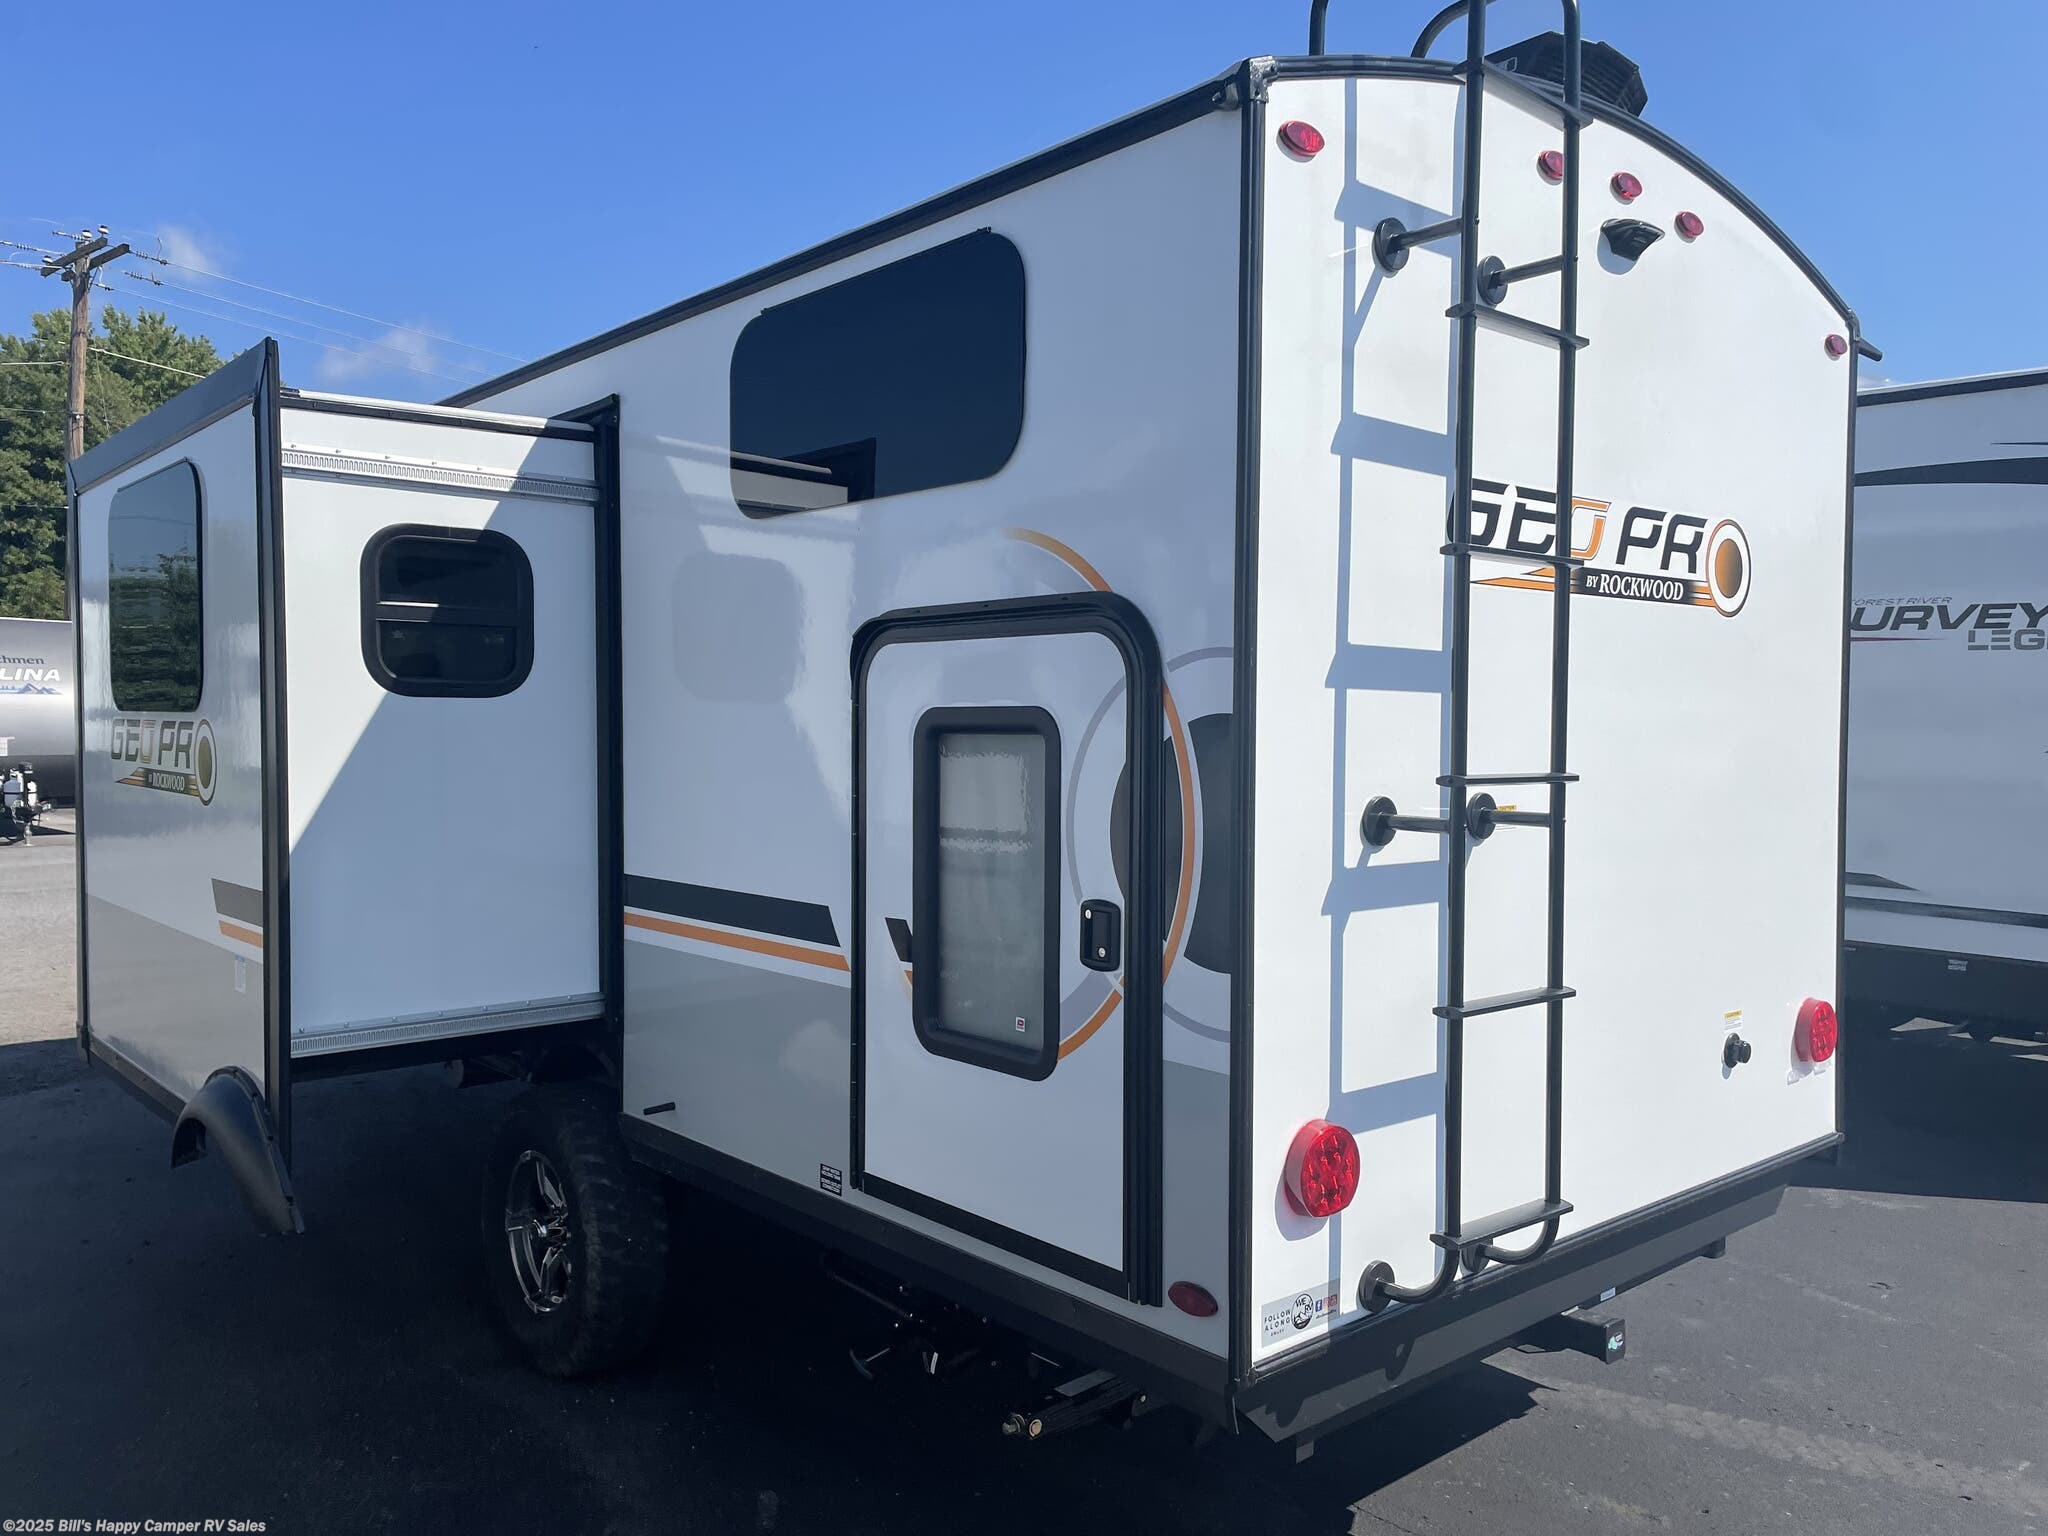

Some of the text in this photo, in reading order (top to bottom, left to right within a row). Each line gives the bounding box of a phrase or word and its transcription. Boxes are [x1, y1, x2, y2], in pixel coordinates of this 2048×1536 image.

[1586, 573, 1684, 600] BY ROCKWOOD
[1906, 596, 1953, 605] RIVER
[1850, 602, 2048, 631] URVEY
[1967, 629, 2048, 651] LEG
[0, 655, 45, 665] hmen
[0, 668, 60, 682] LINA
[1264, 1309, 1291, 1323] FOLLOW
[1264, 1317, 1291, 1331] ALONG
